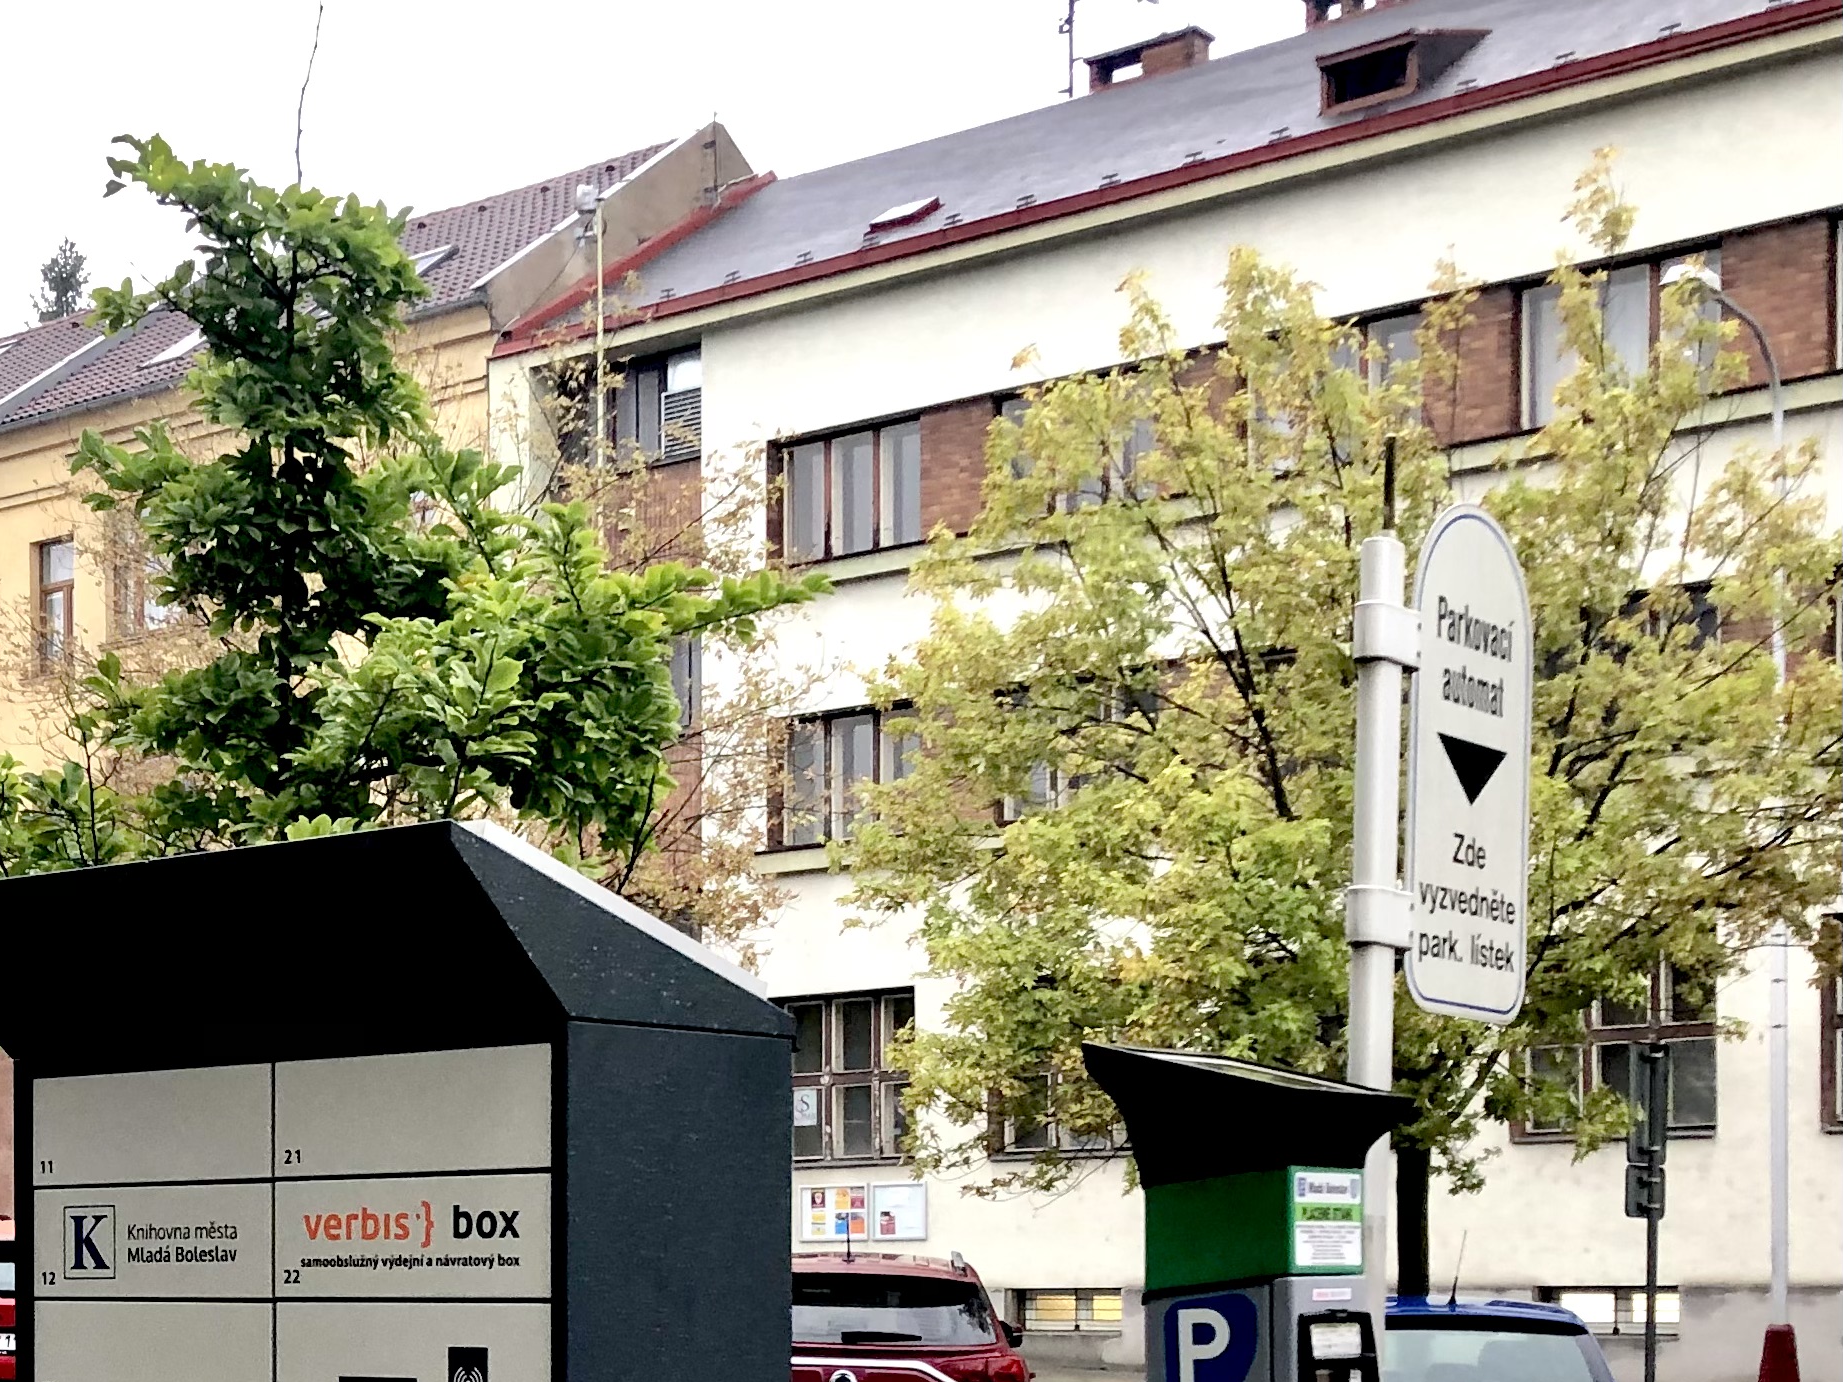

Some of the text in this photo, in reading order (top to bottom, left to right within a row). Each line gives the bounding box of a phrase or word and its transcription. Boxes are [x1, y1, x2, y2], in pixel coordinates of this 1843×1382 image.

[1437, 595, 1515, 662] Parkovací
[1442, 665, 1504, 718] automat
[1452, 832, 1487, 869] Zde
[1418, 881, 1516, 924] vyzvedněte
[1417, 930, 1515, 972] park. lístek
[40, 1160, 54, 1175] 11
[283, 1148, 302, 1165] 21
[127, 1220, 238, 1241] Knihovna města
[452, 1204, 521, 1240] box
[69, 1214, 112, 1270] K
[127, 1244, 238, 1263] Mladá Boleslav
[300, 1252, 521, 1270] samoobslužný výdejní a návratový box
[41, 1271, 56, 1286] 12
[283, 1270, 302, 1285] 22
